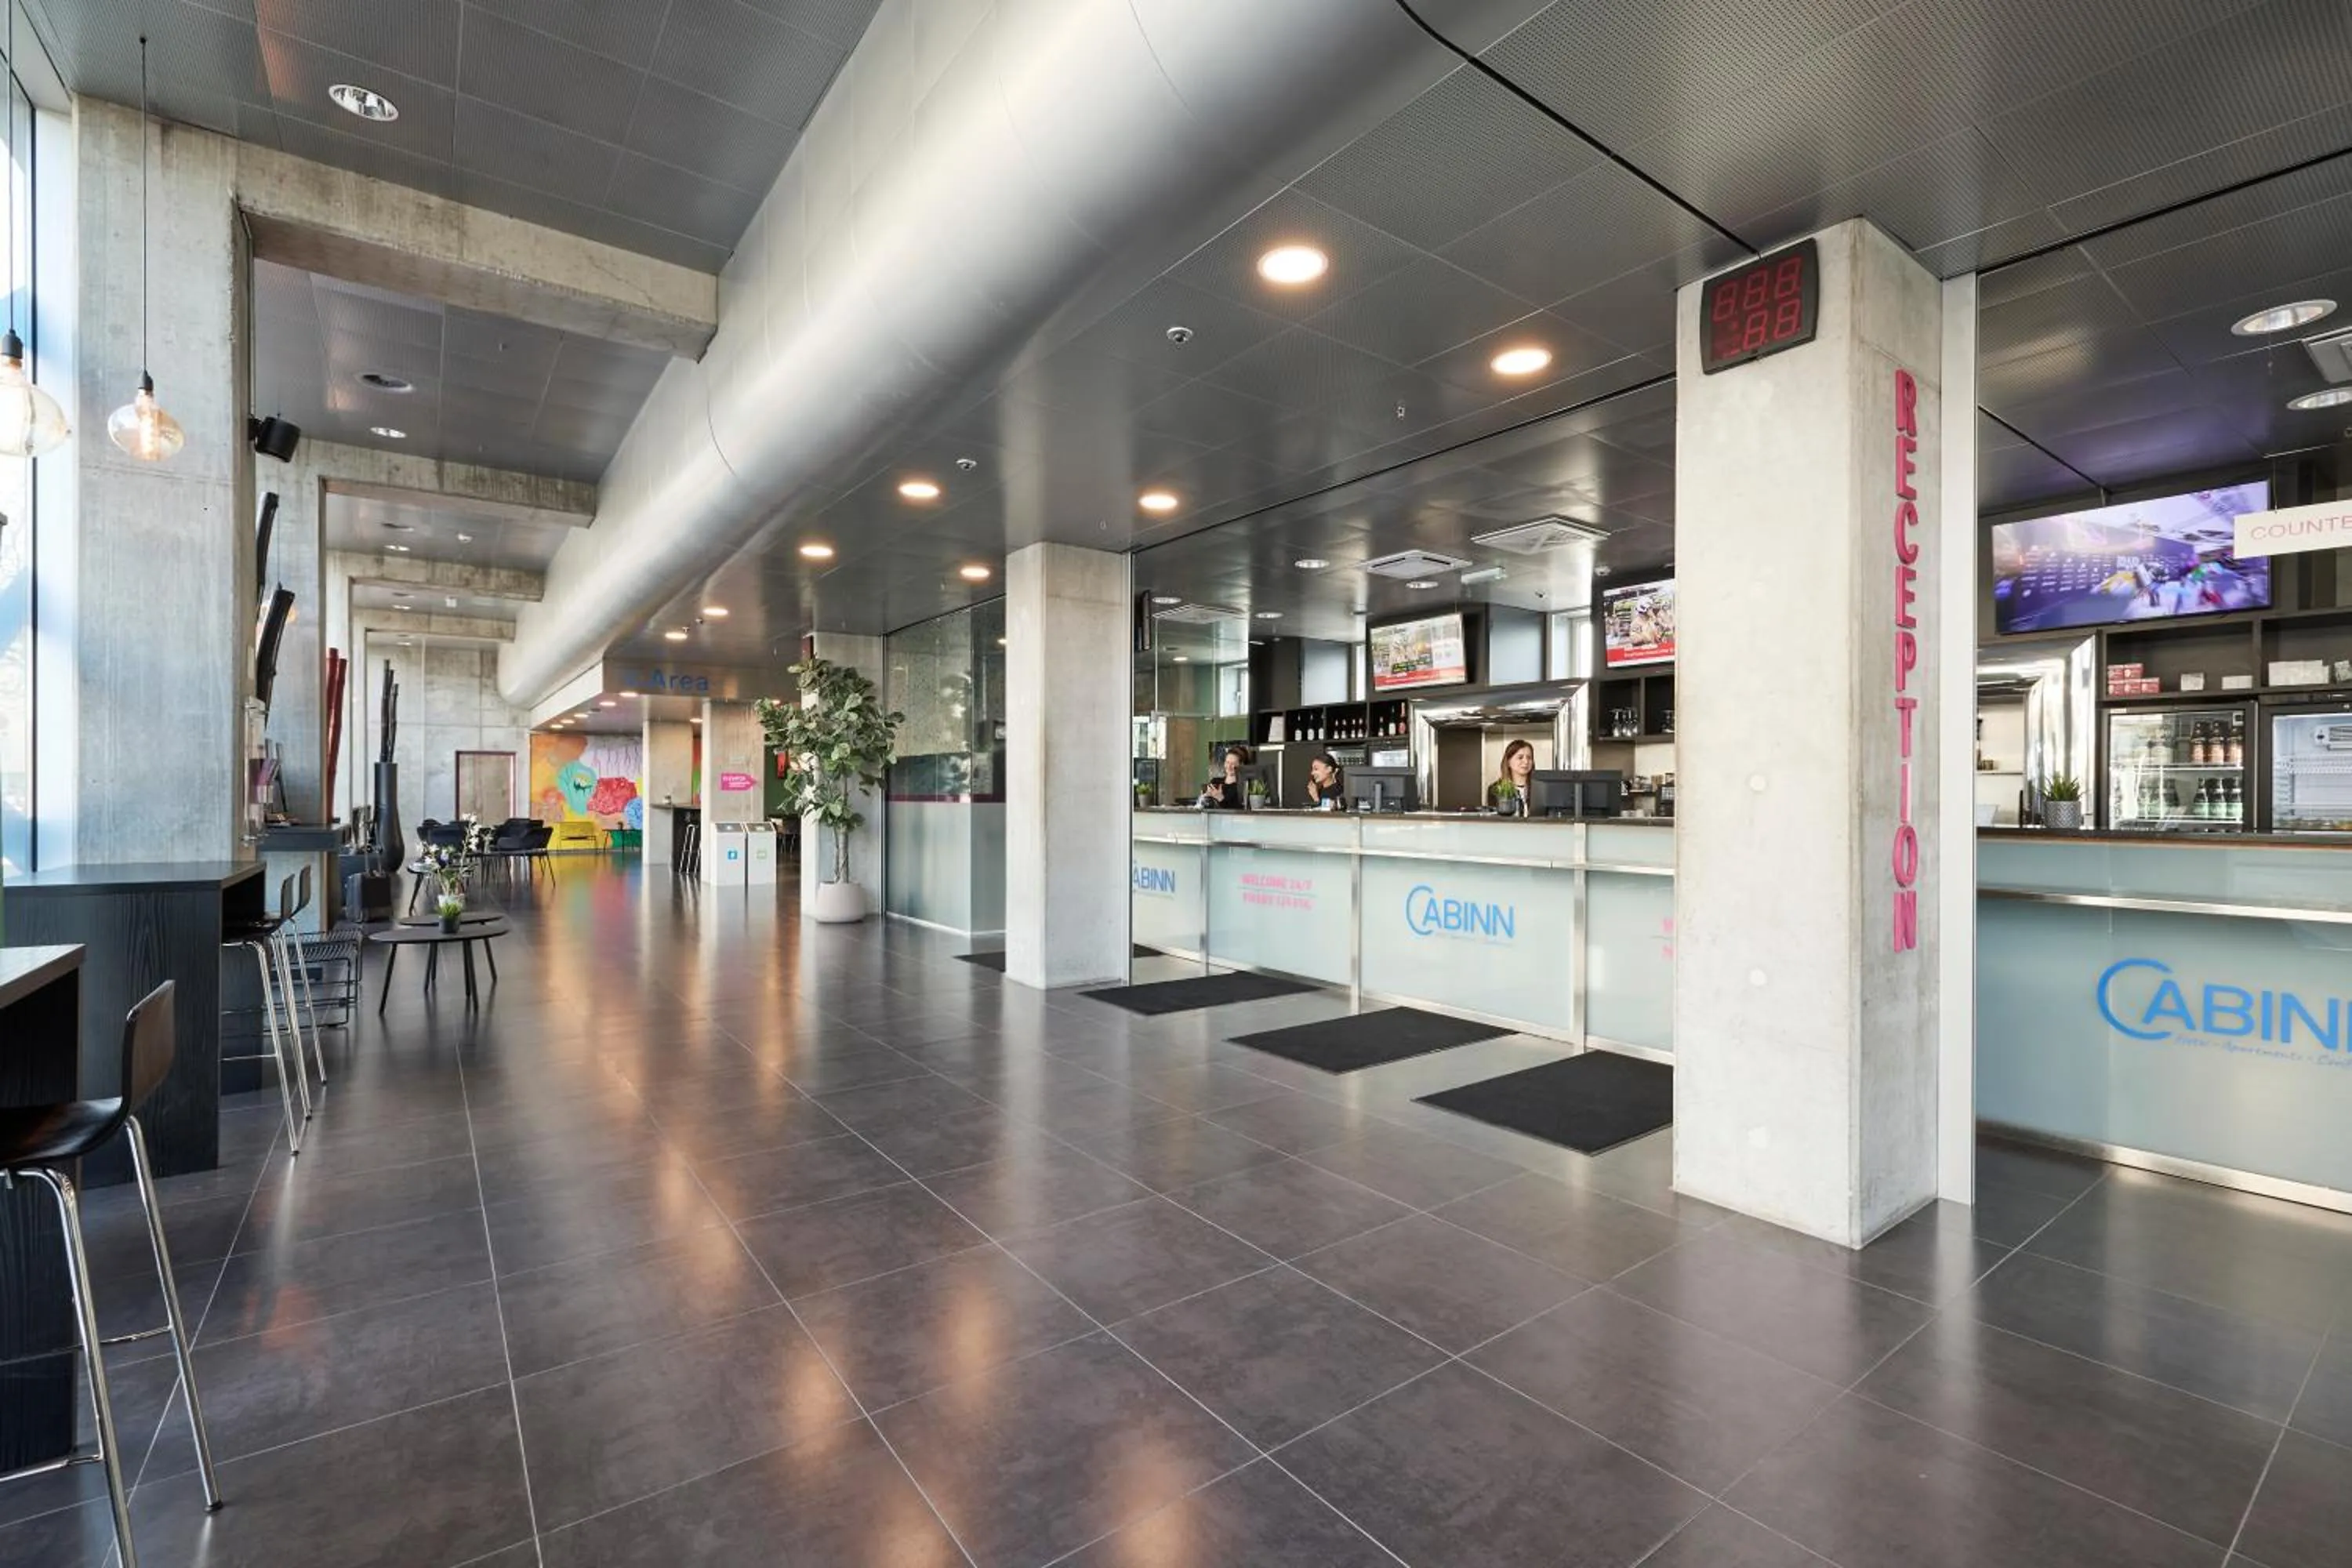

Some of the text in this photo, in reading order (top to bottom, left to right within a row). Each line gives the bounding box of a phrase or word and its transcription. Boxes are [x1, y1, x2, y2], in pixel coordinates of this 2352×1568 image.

[652, 669, 709, 691] Area
[1893, 368, 1918, 953] RECEPTION
[1133, 864, 1175, 894] ABINN
[1406, 885, 1514, 938] CABINN
[2096, 958, 2352, 1054] CABIN
